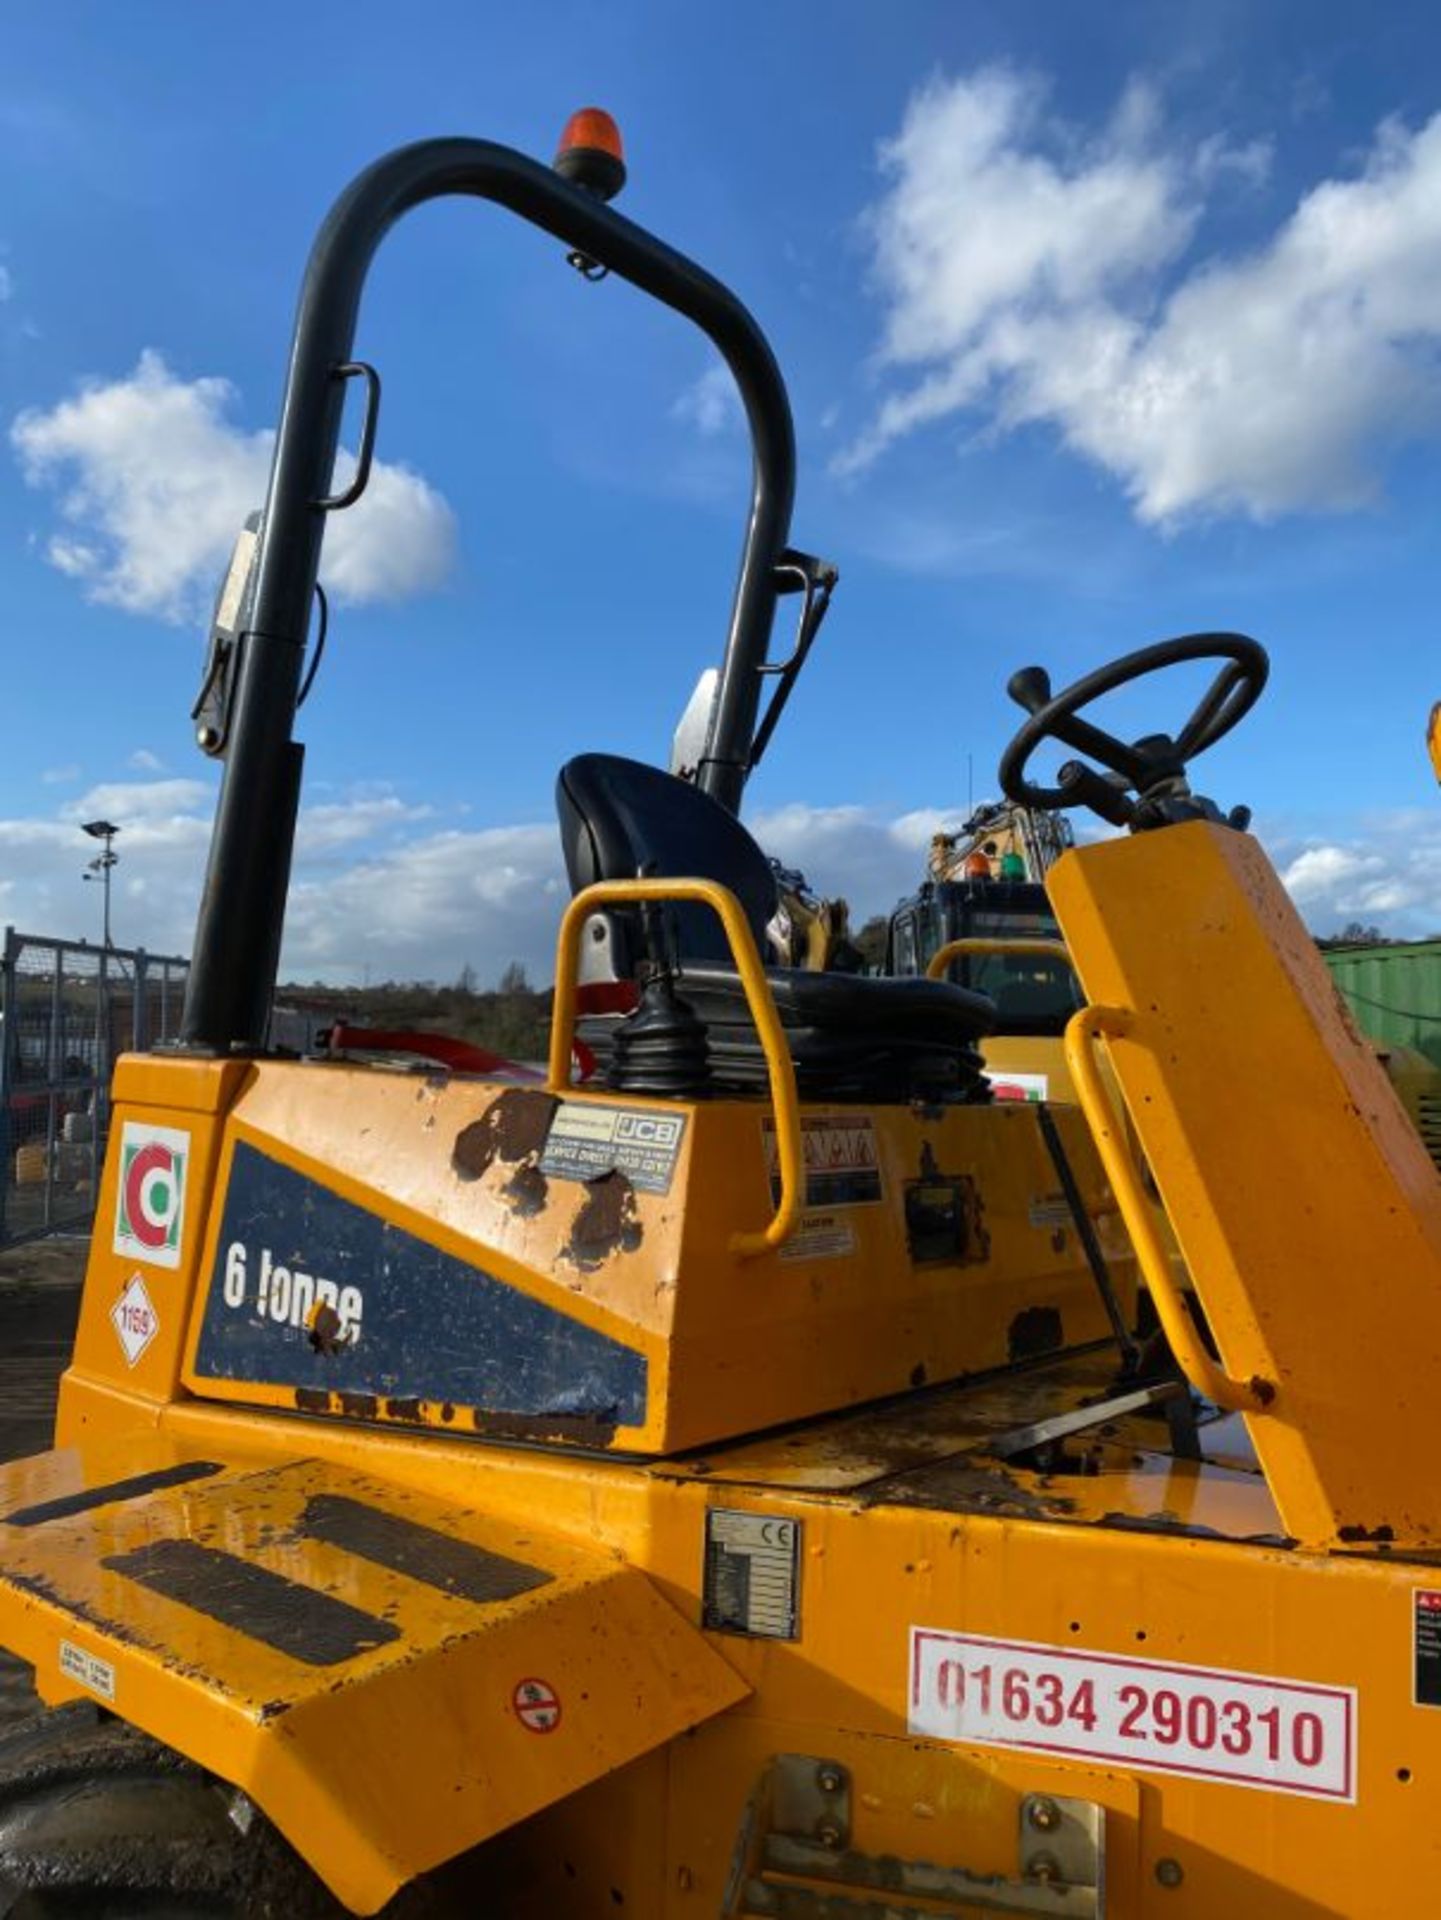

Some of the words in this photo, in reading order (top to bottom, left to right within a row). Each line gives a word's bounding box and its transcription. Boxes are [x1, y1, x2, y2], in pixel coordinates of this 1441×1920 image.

[618, 1117, 674, 1142] JCB
[223, 1241, 247, 1308] 6
[761, 1522, 790, 1546] CE
[936, 1658, 1097, 1733] 01634
[1117, 1684, 1324, 1768] 290310
